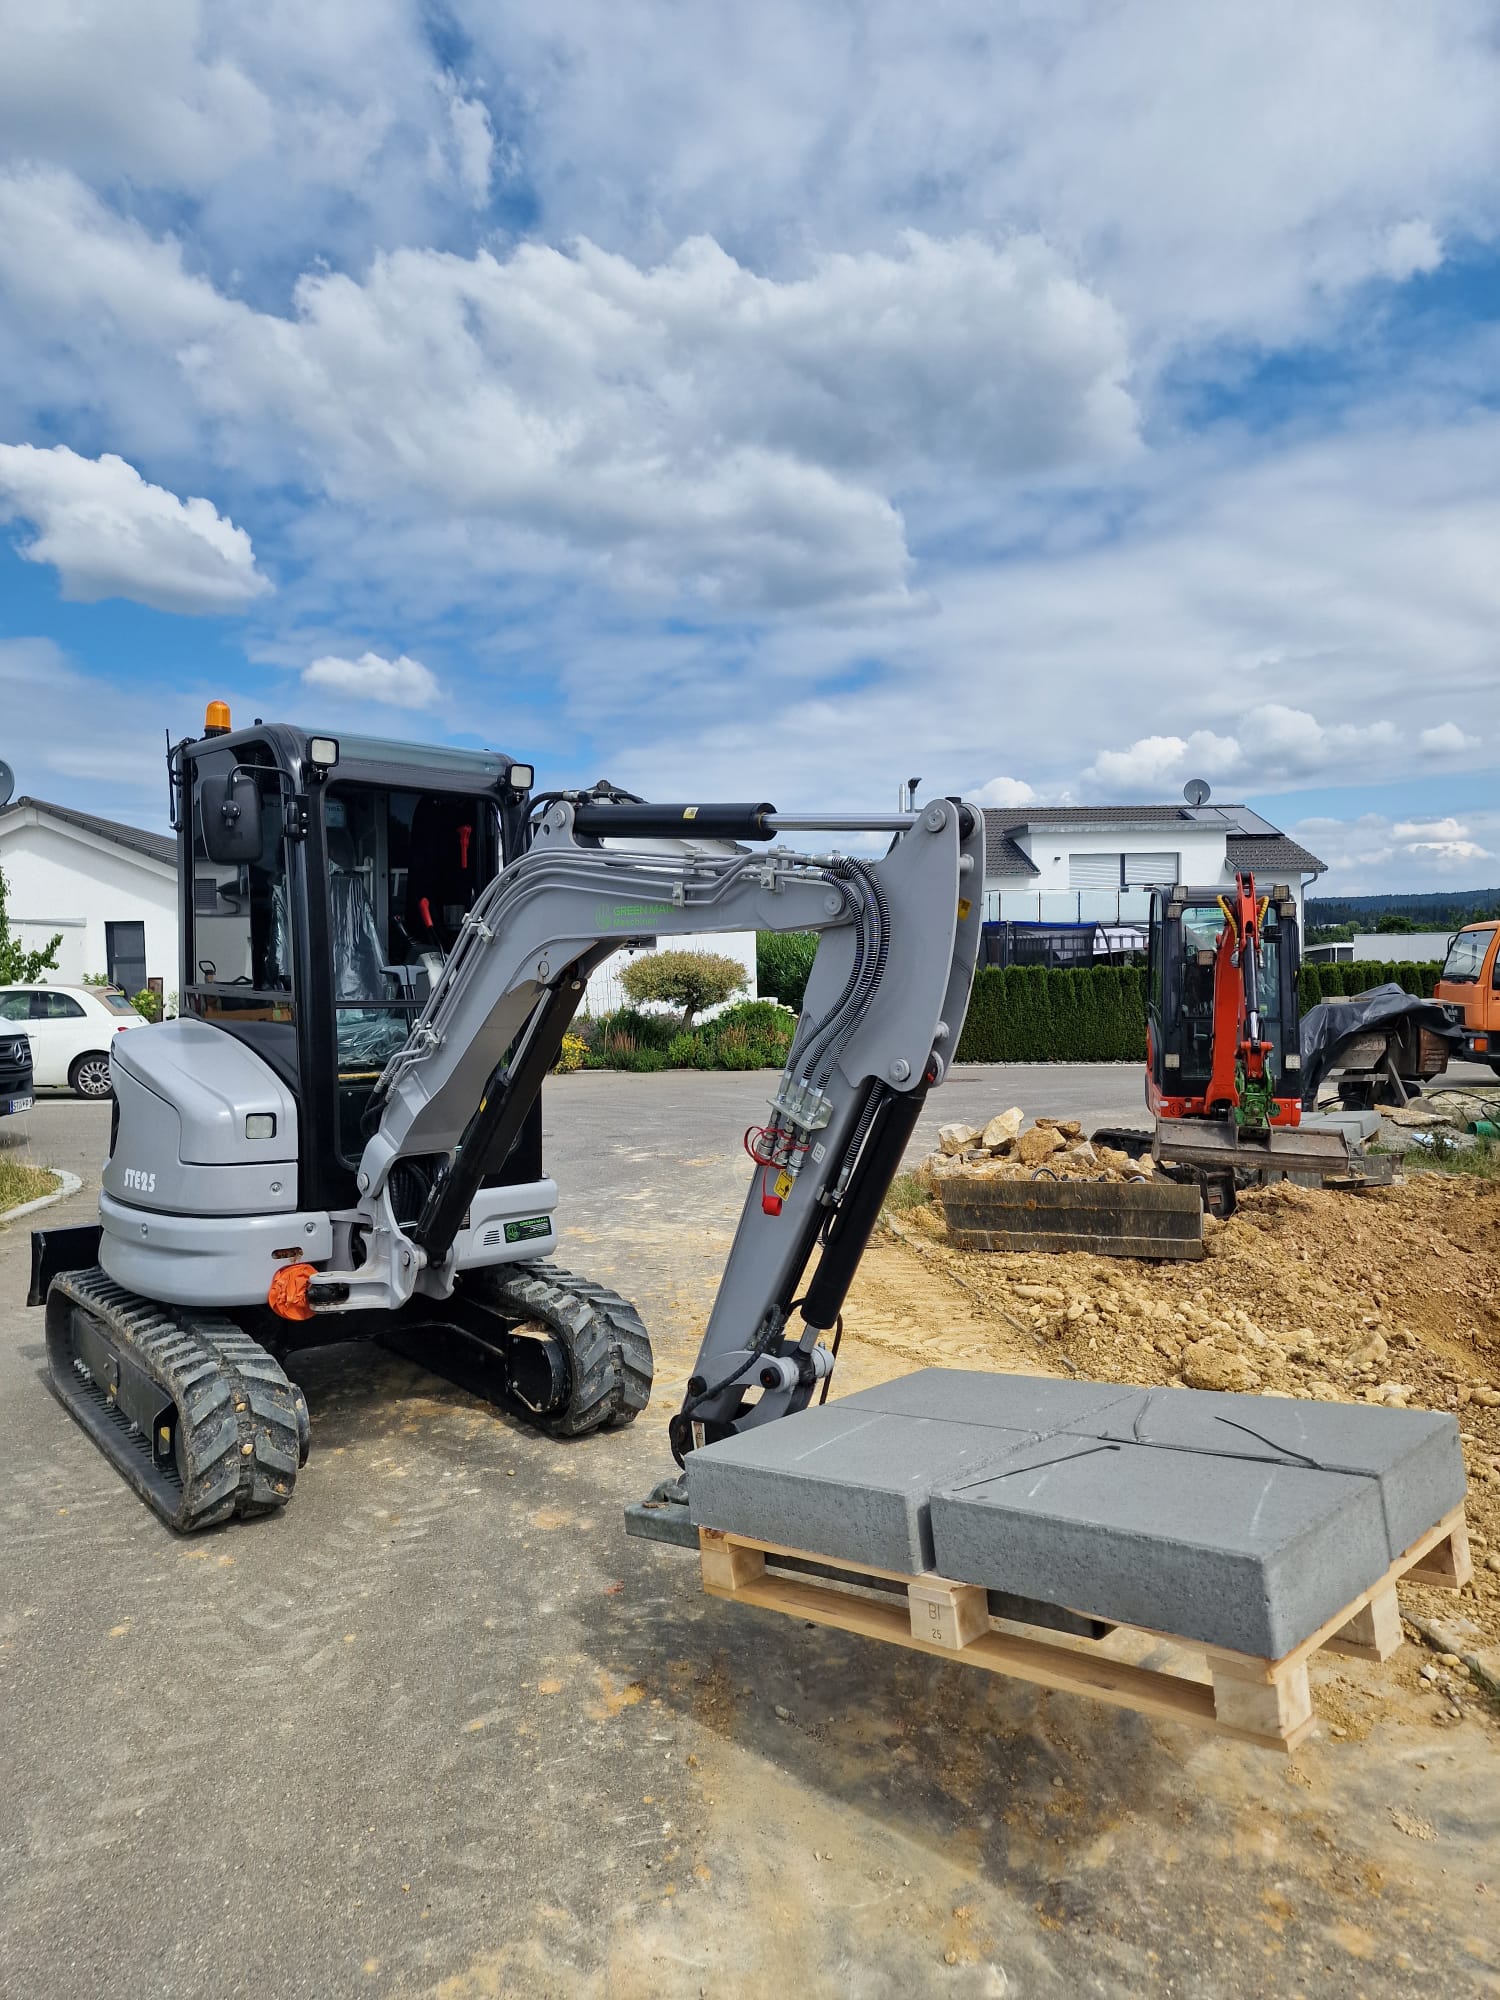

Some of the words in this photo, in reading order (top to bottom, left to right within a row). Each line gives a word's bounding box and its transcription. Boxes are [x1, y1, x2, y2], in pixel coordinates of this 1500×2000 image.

[613, 904, 648, 917] GREEN
[123, 1168, 156, 1193] STE25
[931, 1628, 942, 1640] 25
